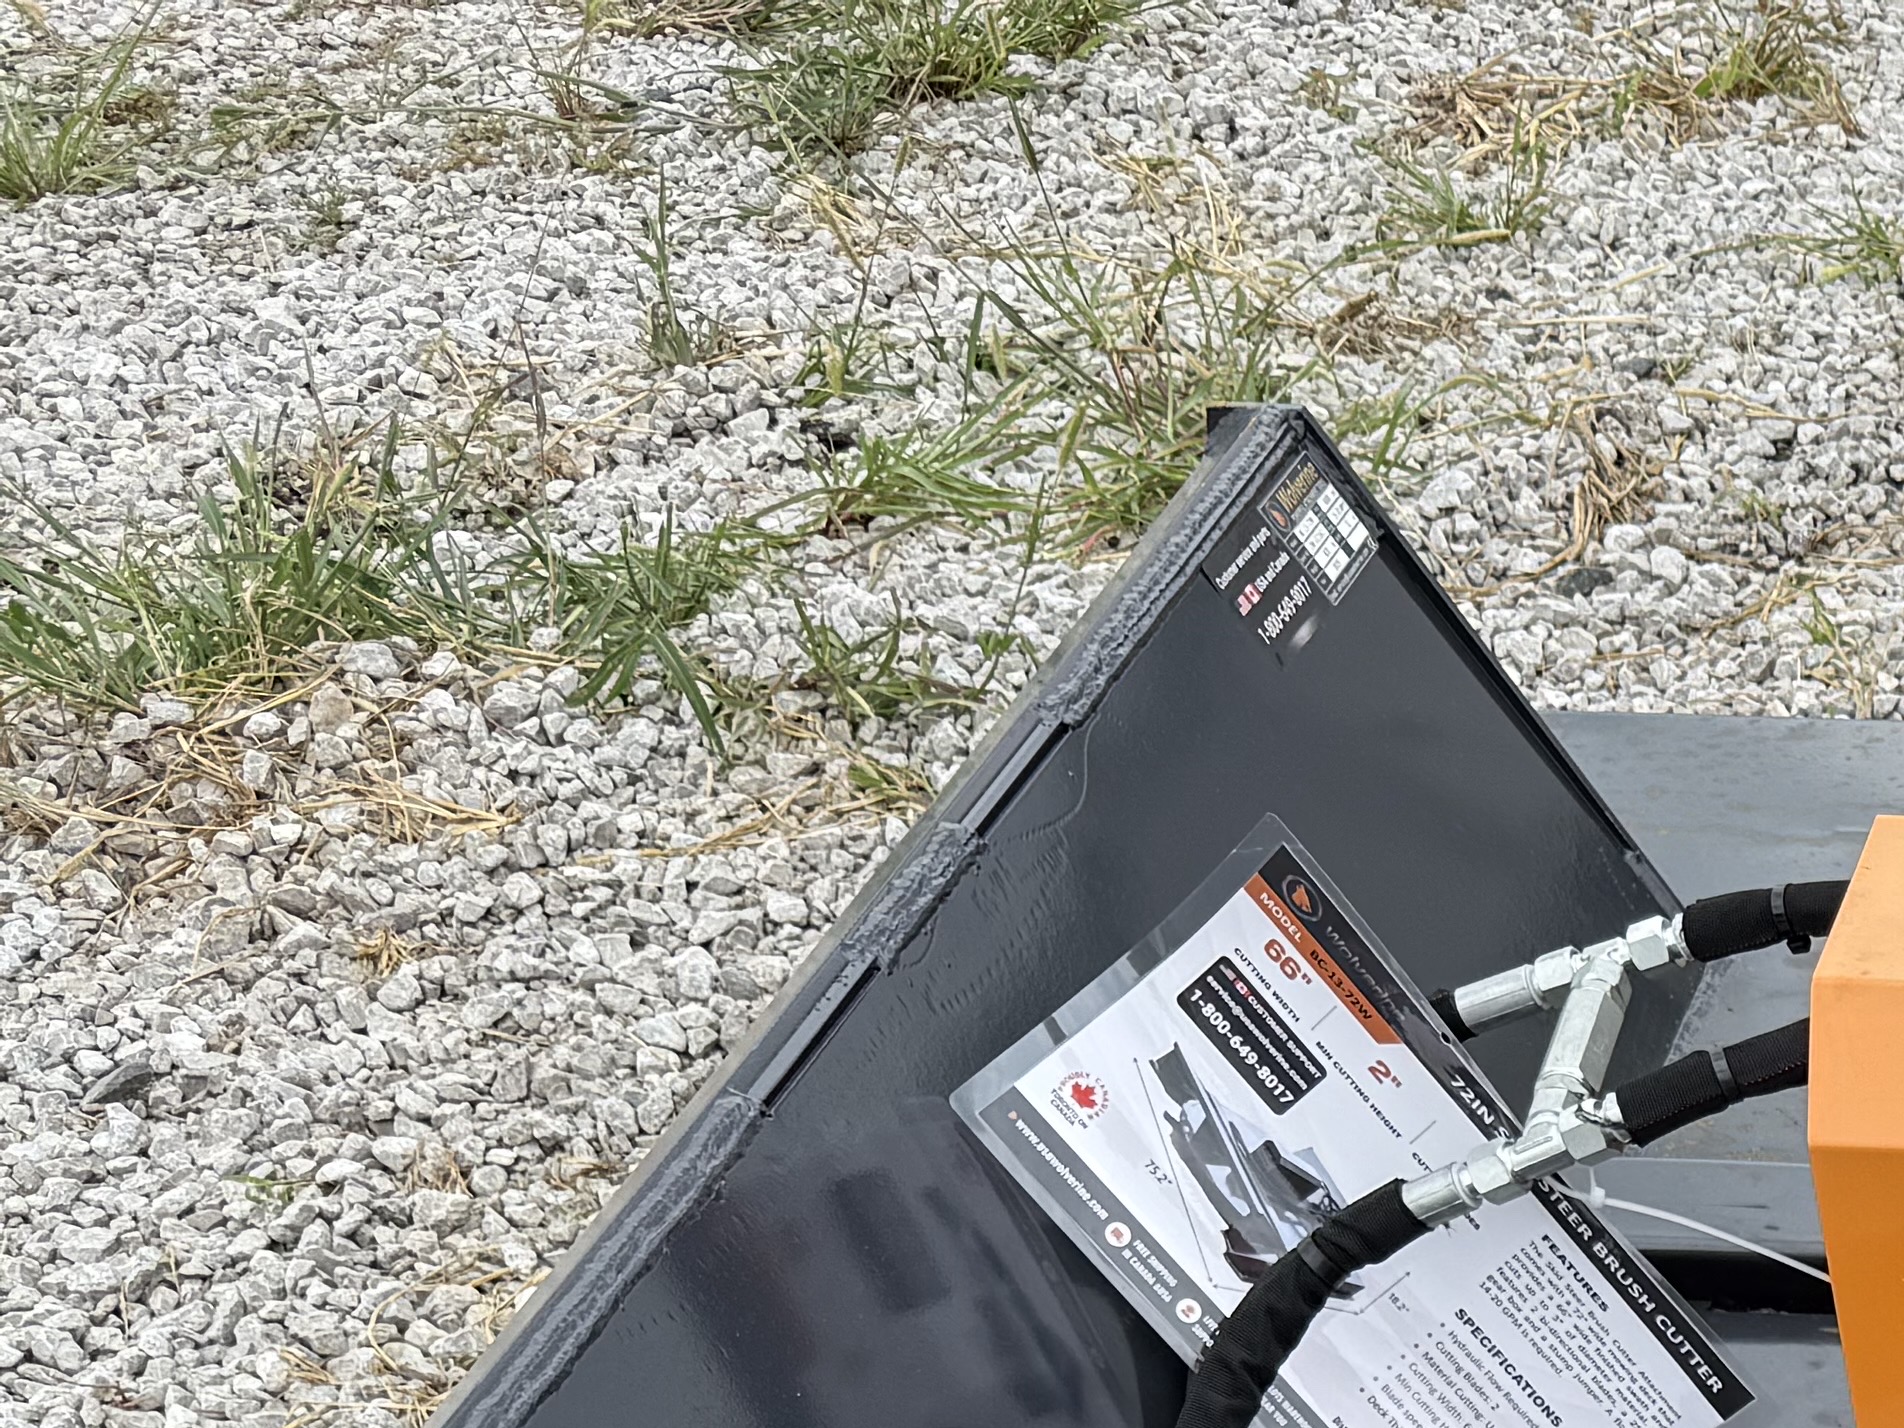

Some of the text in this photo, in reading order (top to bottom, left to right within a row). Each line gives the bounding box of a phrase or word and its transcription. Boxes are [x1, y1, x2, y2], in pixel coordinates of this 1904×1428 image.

[1232, 945, 1301, 1024] CUTTING WIDTH
[1258, 891, 1373, 1022] MODEL BC-13-72W
[1260, 935, 1314, 993] 66"
[1186, 986, 1295, 1107] 1-800-649-8017
[1245, 993, 1322, 1080] CUSTOMER SUPPORT
[1366, 1057, 1403, 1096] 2"
[1049, 1097, 1077, 1127] CANADA
[1314, 1040, 1403, 1140] MIN CUTTING HEIGHT
[1012, 1116, 1111, 1222] www.usawolverine.com
[1447, 1072, 1725, 1395] 72IN STEER BRUSH CUTTER
[1539, 1232, 1611, 1314] FEATURES
[1478, 1280, 1504, 1308] 14-20
[1500, 1305, 1524, 1330] GPM
[1485, 1272, 1508, 1295] gear
[1505, 1294, 1524, 1314] box
[1521, 1313, 1541, 1334] and
[1546, 1342, 1575, 1373] stump
[1495, 1265, 1530, 1304] features
[1538, 1315, 1591, 1374] bi-directional
[1503, 1258, 1524, 1280] cuts
[1575, 1342, 1614, 1384] diameter
[1511, 1252, 1548, 1292] provides
[1571, 1321, 1594, 1346] wide
[1592, 1346, 1626, 1383] finished
[1518, 1246, 1547, 1277] comes
[1545, 1276, 1566, 1299] with
[1586, 1324, 1608, 1348] wide
[1656, 1405, 1676, 1426] that
[1526, 1240, 1545, 1259] The
[1544, 1260, 1564, 1282] Skid
[1563, 1282, 1587, 1308] Steer
[1586, 1309, 1612, 1337] Brush
[1611, 1338, 1638, 1367] Cutter
[1379, 1382, 1407, 1411] Blade
[1393, 1371, 1415, 1393] Min
[1408, 1389, 1443, 1426] Cutting
[1405, 1360, 1440, 1397] Cutting
[1420, 1350, 1457, 1390] Material
[1451, 1386, 1487, 1424] Cutting:
[1432, 1339, 1500, 1412] Cutting Blades: 2
[1445, 1329, 1486, 1373] Hydraulic
[1482, 1368, 1506, 1394] Flow
[1365, 1393, 1390, 1419] Deck
